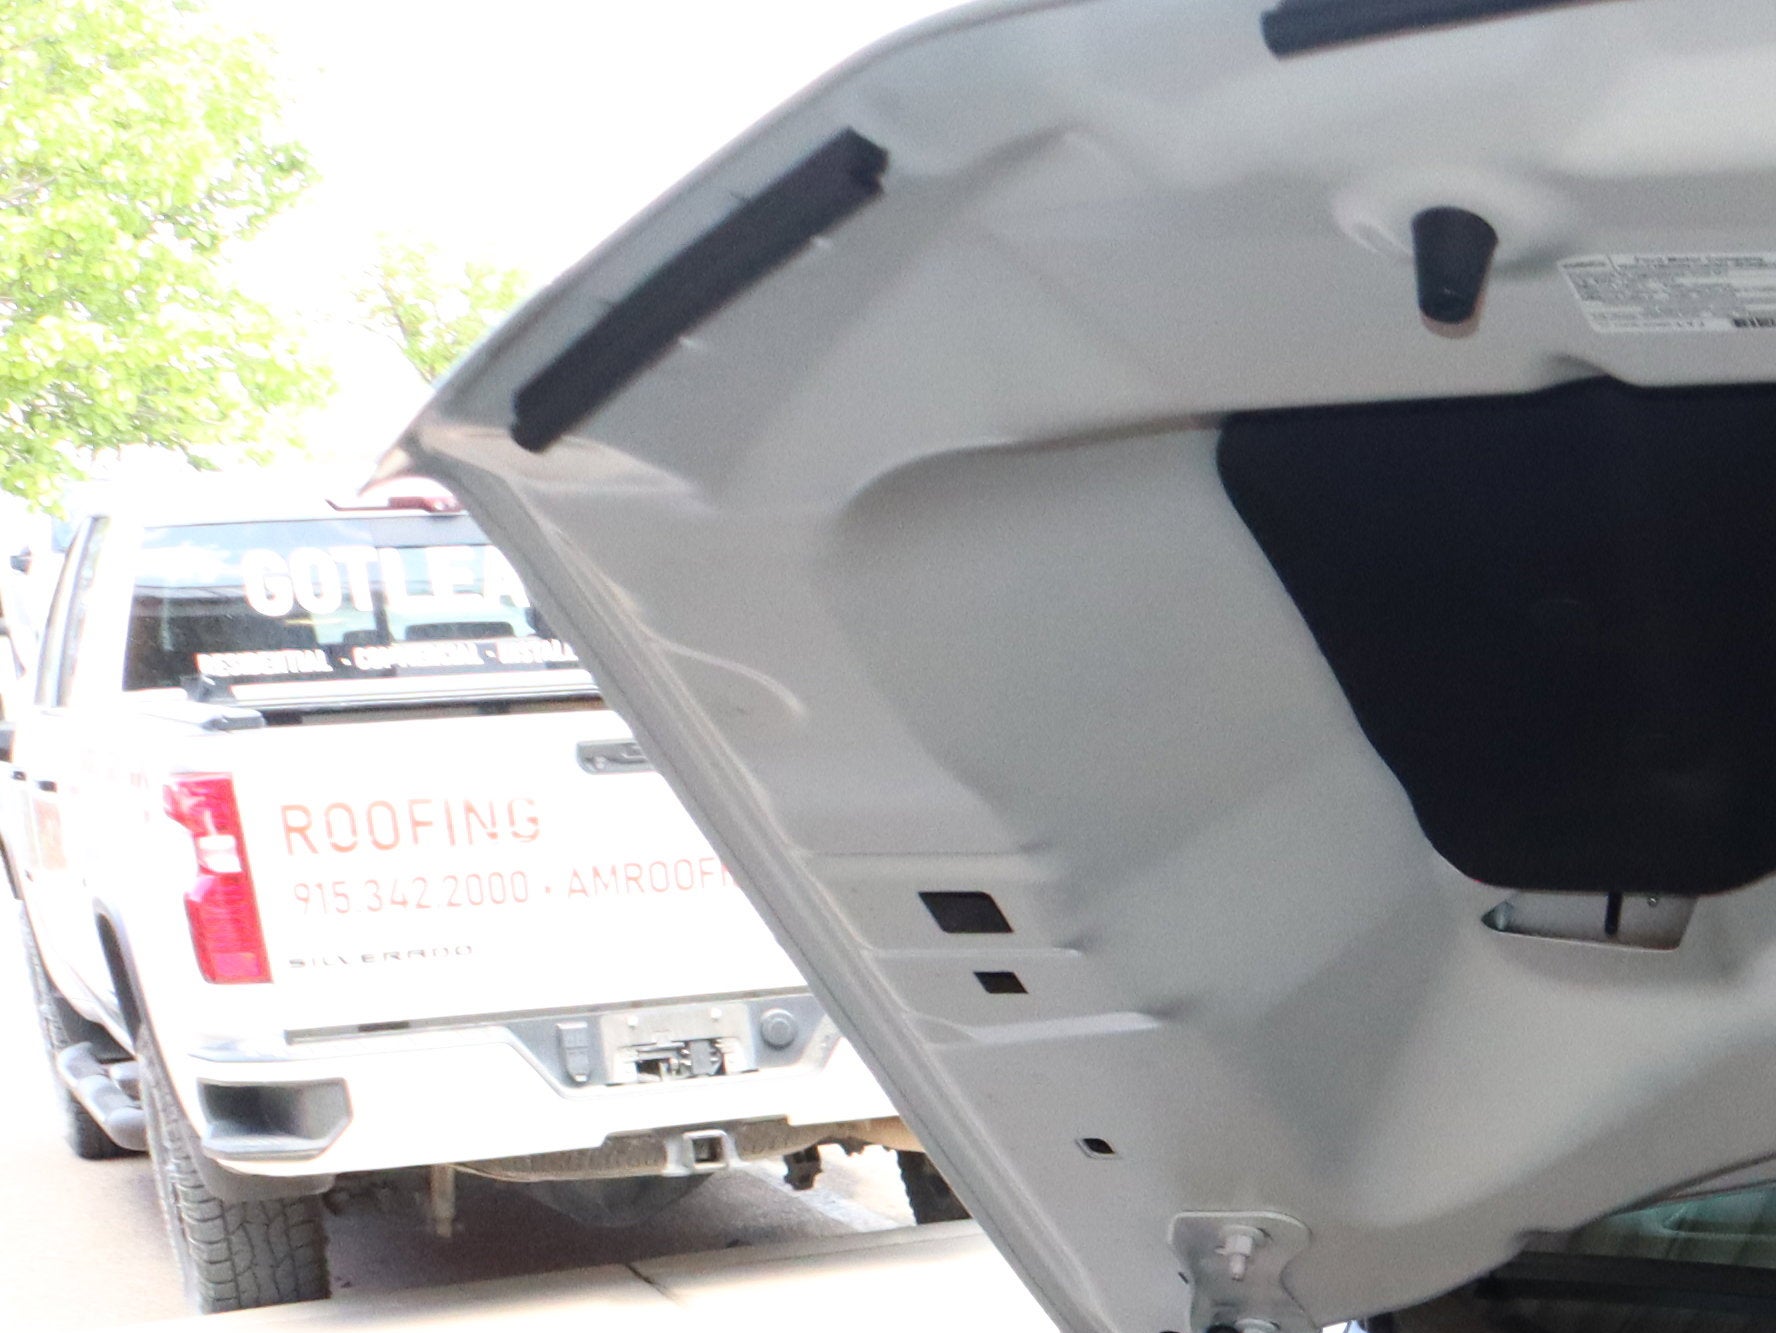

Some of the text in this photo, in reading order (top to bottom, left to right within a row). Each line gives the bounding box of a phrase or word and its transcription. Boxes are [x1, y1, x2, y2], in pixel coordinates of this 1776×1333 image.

[279, 797, 543, 856] ROOFING
[292, 870, 530, 916] 915.342.2000
[288, 944, 474, 969] SILVERADO
